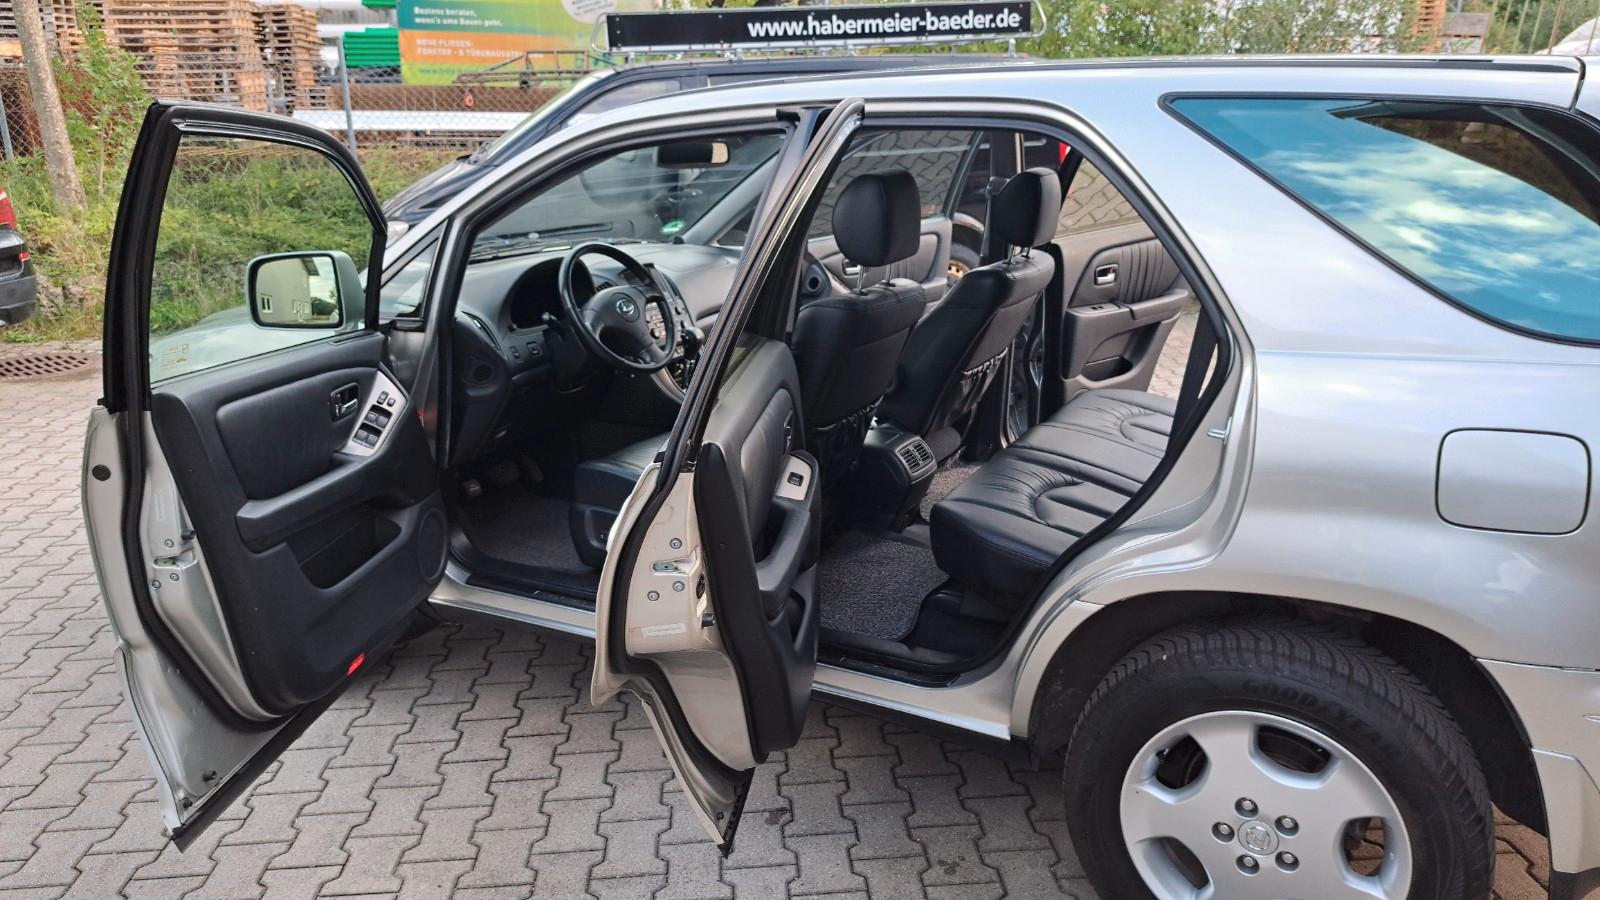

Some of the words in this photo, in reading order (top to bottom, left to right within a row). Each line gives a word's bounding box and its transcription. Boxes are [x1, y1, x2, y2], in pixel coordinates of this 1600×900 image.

[414, 6, 444, 15] Bestens
[460, 18, 482, 26] Bauen
[747, 8, 1020, 38] www.habermeier-baeder.de
